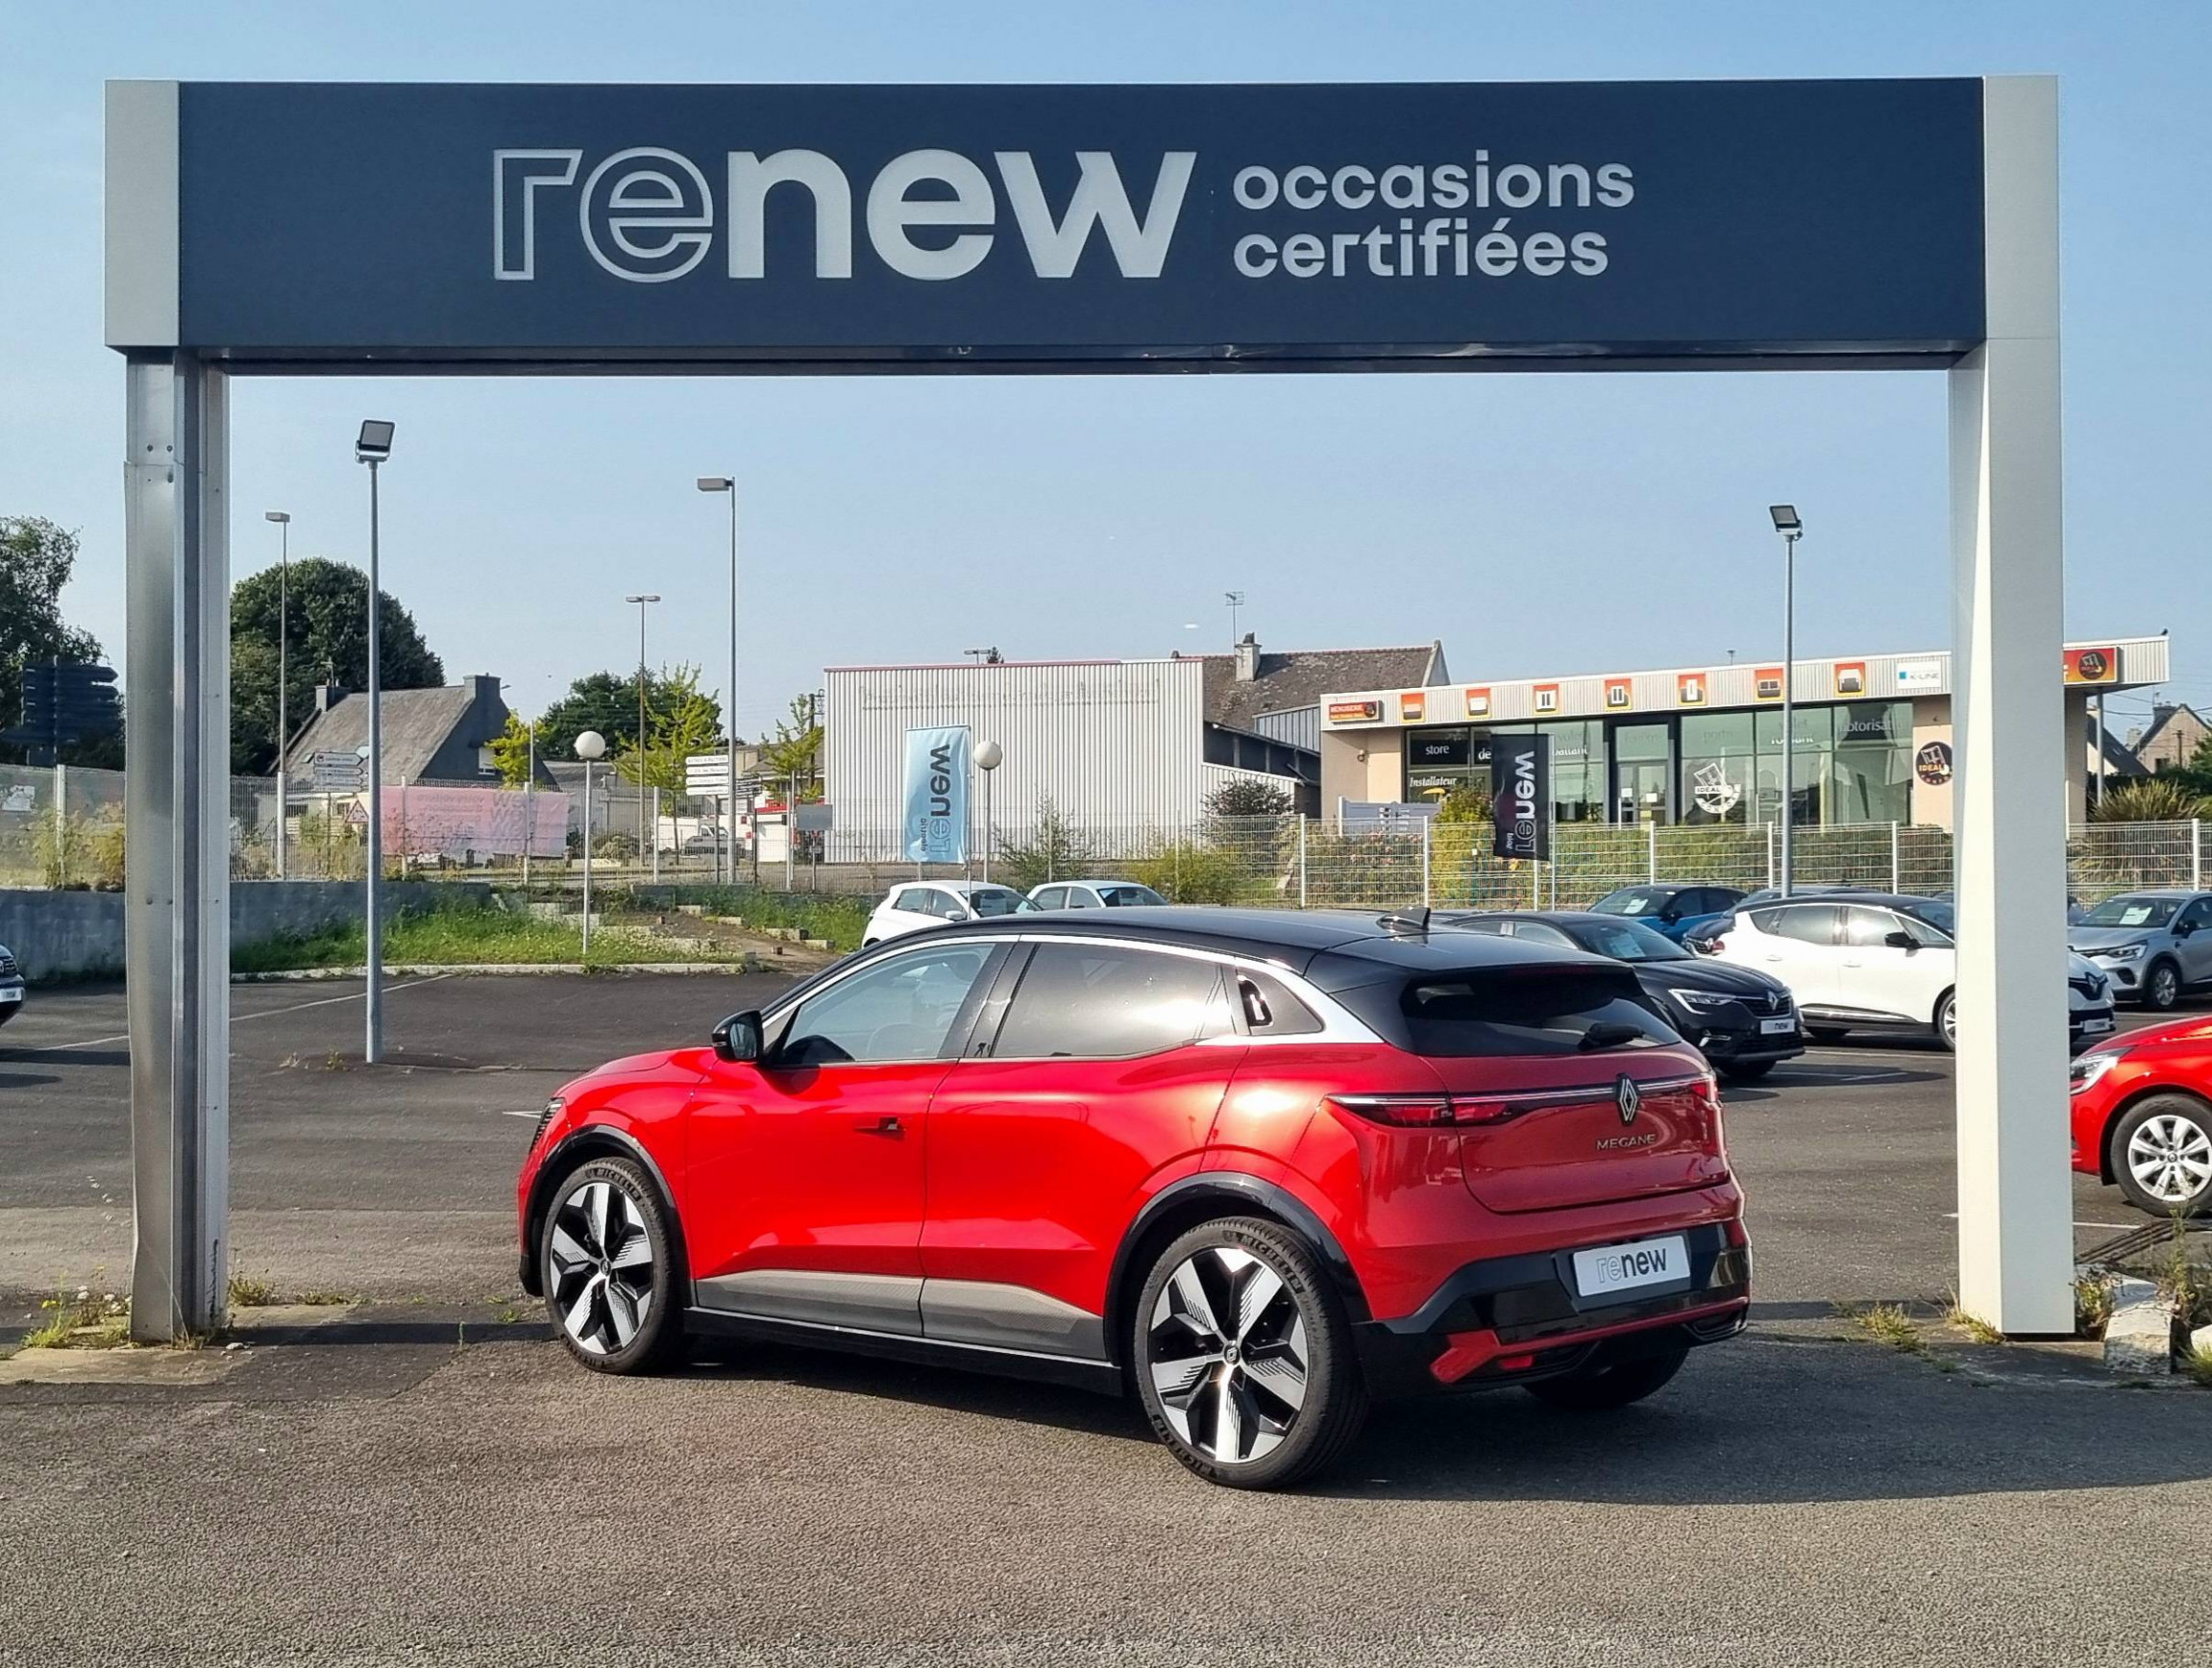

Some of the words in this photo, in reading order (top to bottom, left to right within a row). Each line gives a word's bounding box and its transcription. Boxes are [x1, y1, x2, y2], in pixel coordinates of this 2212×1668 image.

[1233, 149, 1634, 209] occasions
[493, 146, 1198, 283] renew
[1233, 217, 1609, 278] certifiées
[1425, 745, 1450, 755] store
[1596, 1134, 1656, 1151] MEGANE
[1241, 1234, 1305, 1291] MICHELIN
[1596, 1248, 1666, 1284] renew
